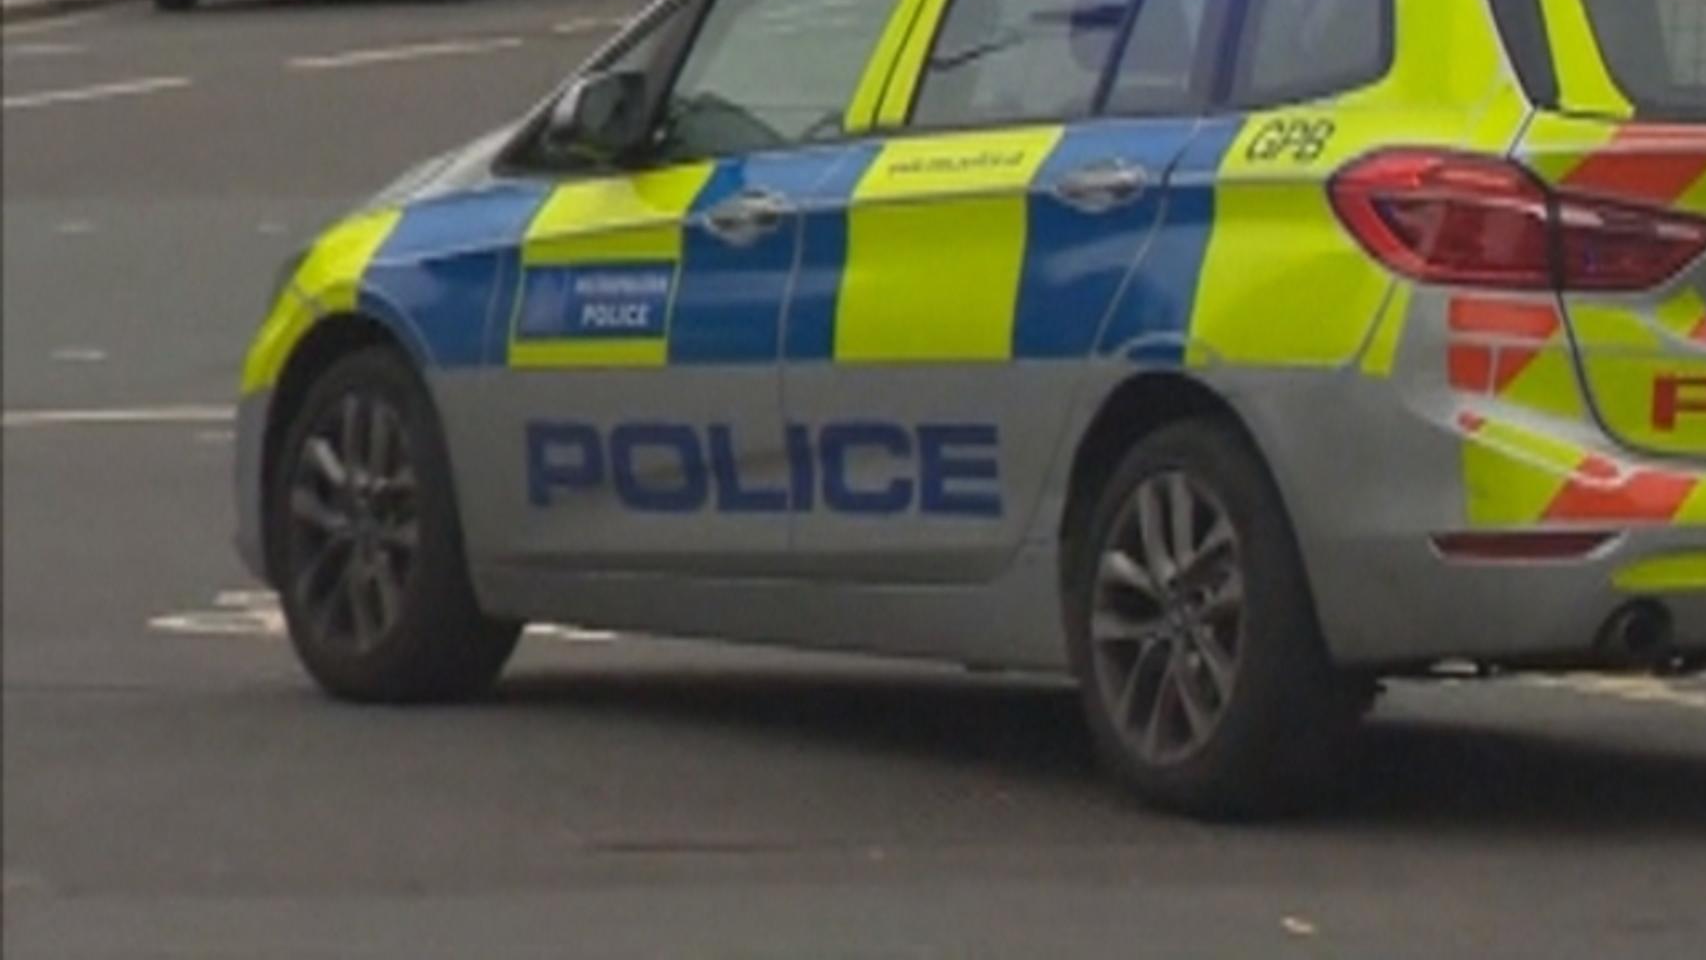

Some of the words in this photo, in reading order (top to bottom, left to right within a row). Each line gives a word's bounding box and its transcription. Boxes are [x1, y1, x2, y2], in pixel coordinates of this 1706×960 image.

[1245, 118, 1335, 162] GPB
[580, 303, 649, 328] POLICE
[526, 419, 1003, 517] POLICE
